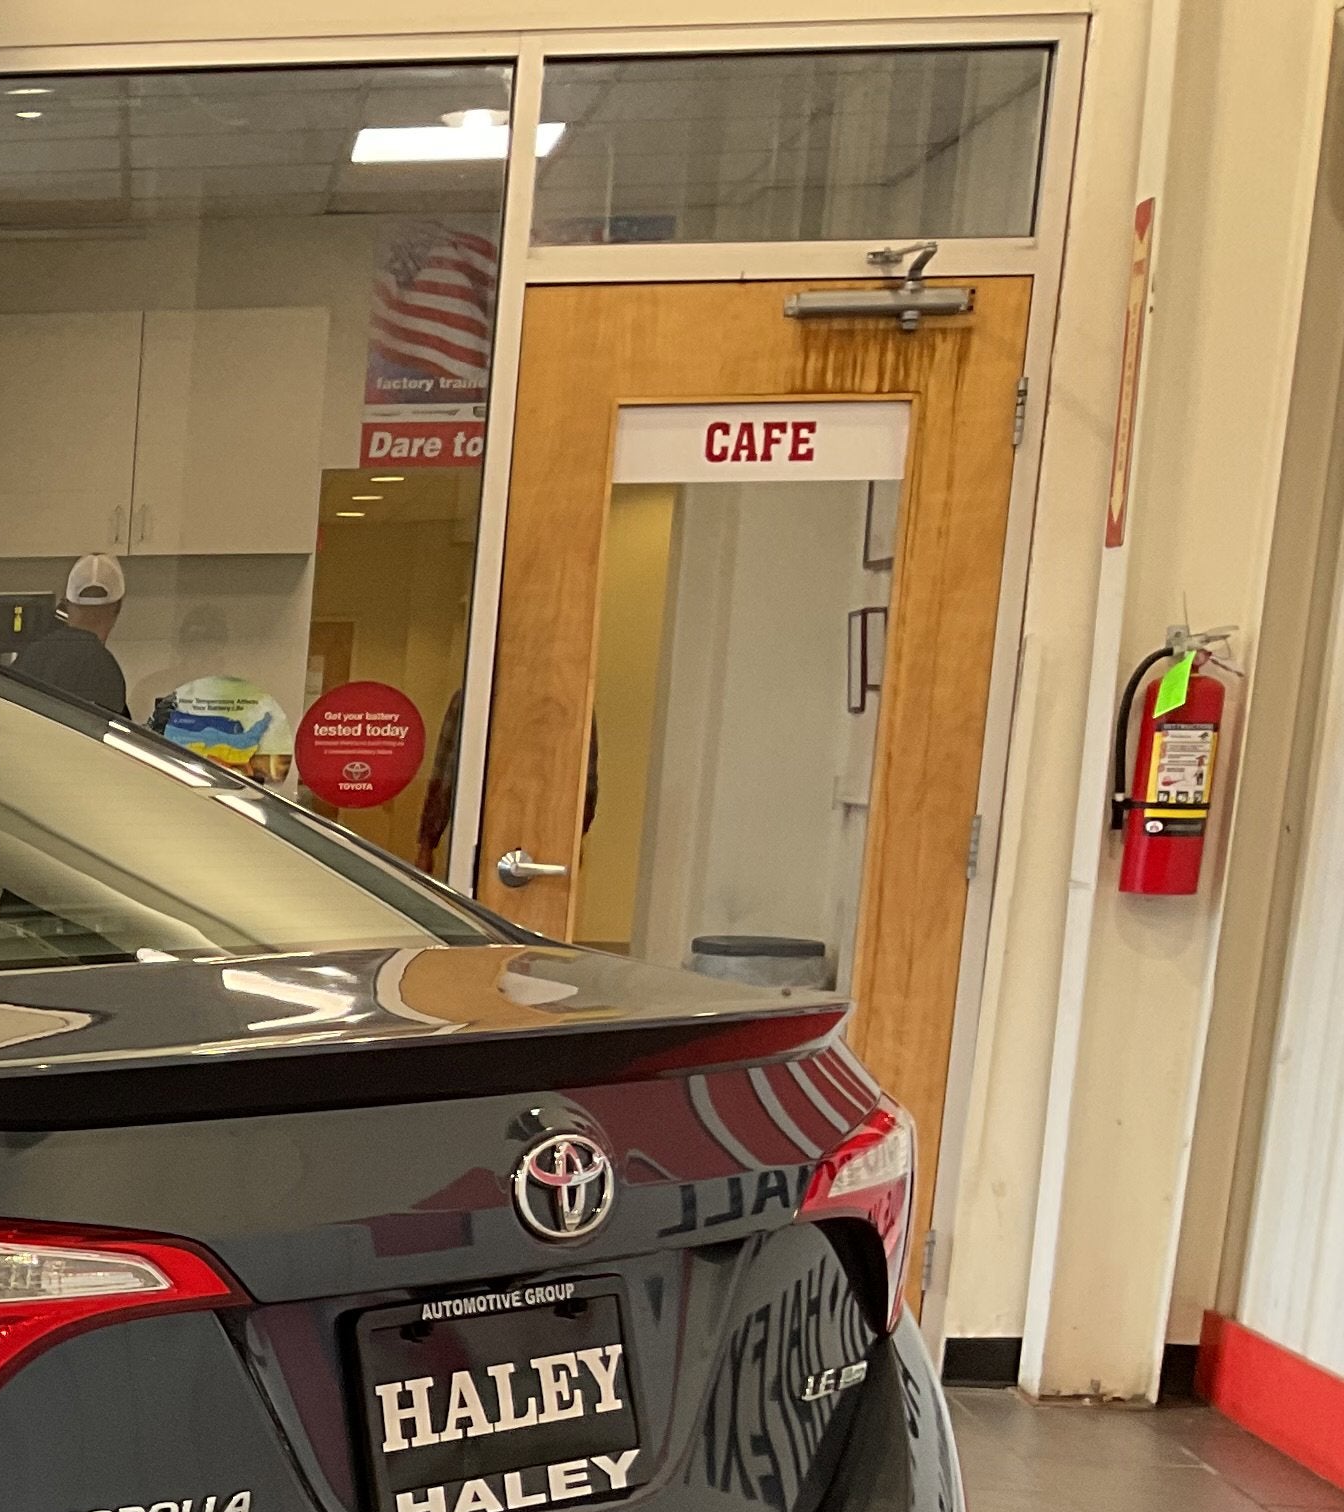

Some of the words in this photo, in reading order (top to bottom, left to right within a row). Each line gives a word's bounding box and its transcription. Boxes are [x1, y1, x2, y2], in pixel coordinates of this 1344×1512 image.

[377, 377, 434, 391] factory
[368, 431, 442, 458] Dare
[705, 421, 817, 462] CAFE
[324, 712, 341, 721] Get
[343, 713, 364, 722] your
[365, 711, 400, 722] battery
[313, 723, 362, 736] tested
[366, 723, 409, 738] today
[338, 782, 373, 791] TOYOTA
[421, 1290, 522, 1321] AUTOMOTIVE
[524, 1282, 575, 1305] GROUP
[375, 1343, 623, 1453] HALEY
